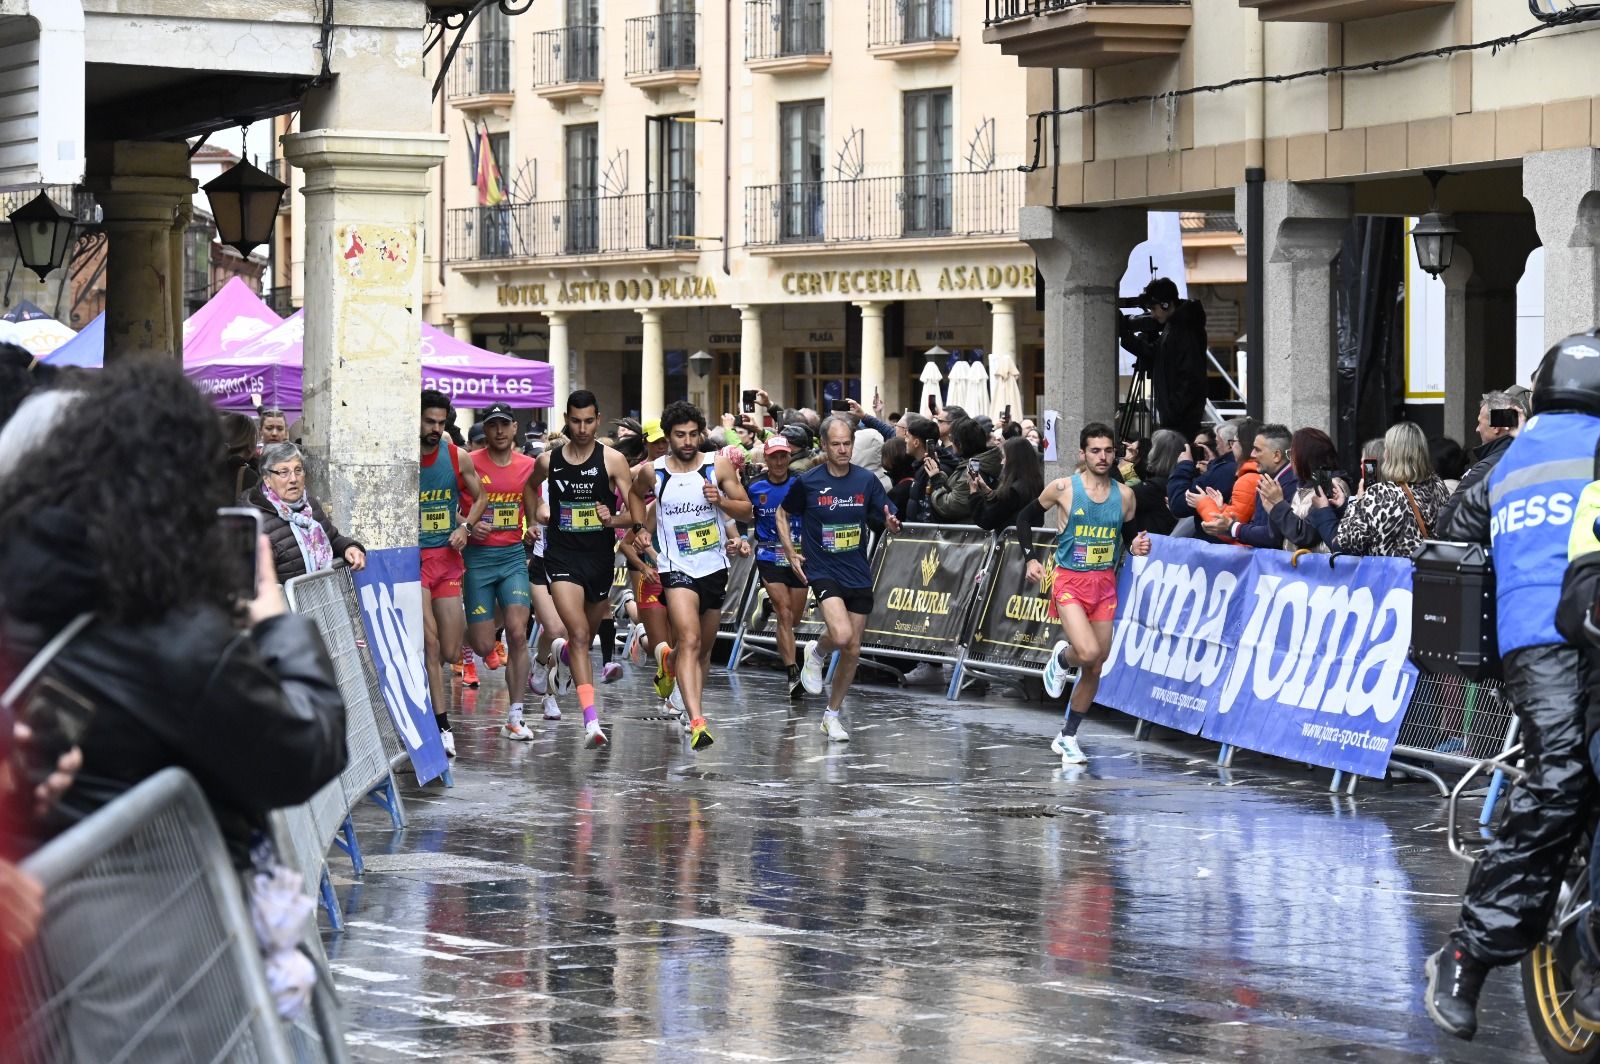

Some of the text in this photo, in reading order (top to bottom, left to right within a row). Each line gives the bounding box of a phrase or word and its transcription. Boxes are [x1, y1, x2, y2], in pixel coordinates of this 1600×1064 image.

[497, 282, 548, 306] HOTEL
[658, 274, 717, 300] PLAZA
[781, 264, 1037, 296] CERVECERIA ASADOR
[421, 374, 533, 399] asport.es
[433, 521, 439, 530] 5
[503, 517, 510, 526] 11
[583, 518, 590, 526] 8
[1490, 492, 1574, 547] PRESS
[701, 537, 708, 546] 3
[1097, 555, 1103, 563] 2
[886, 587, 952, 615] CAJA RURAL
[1005, 594, 1035, 620] CAJA
